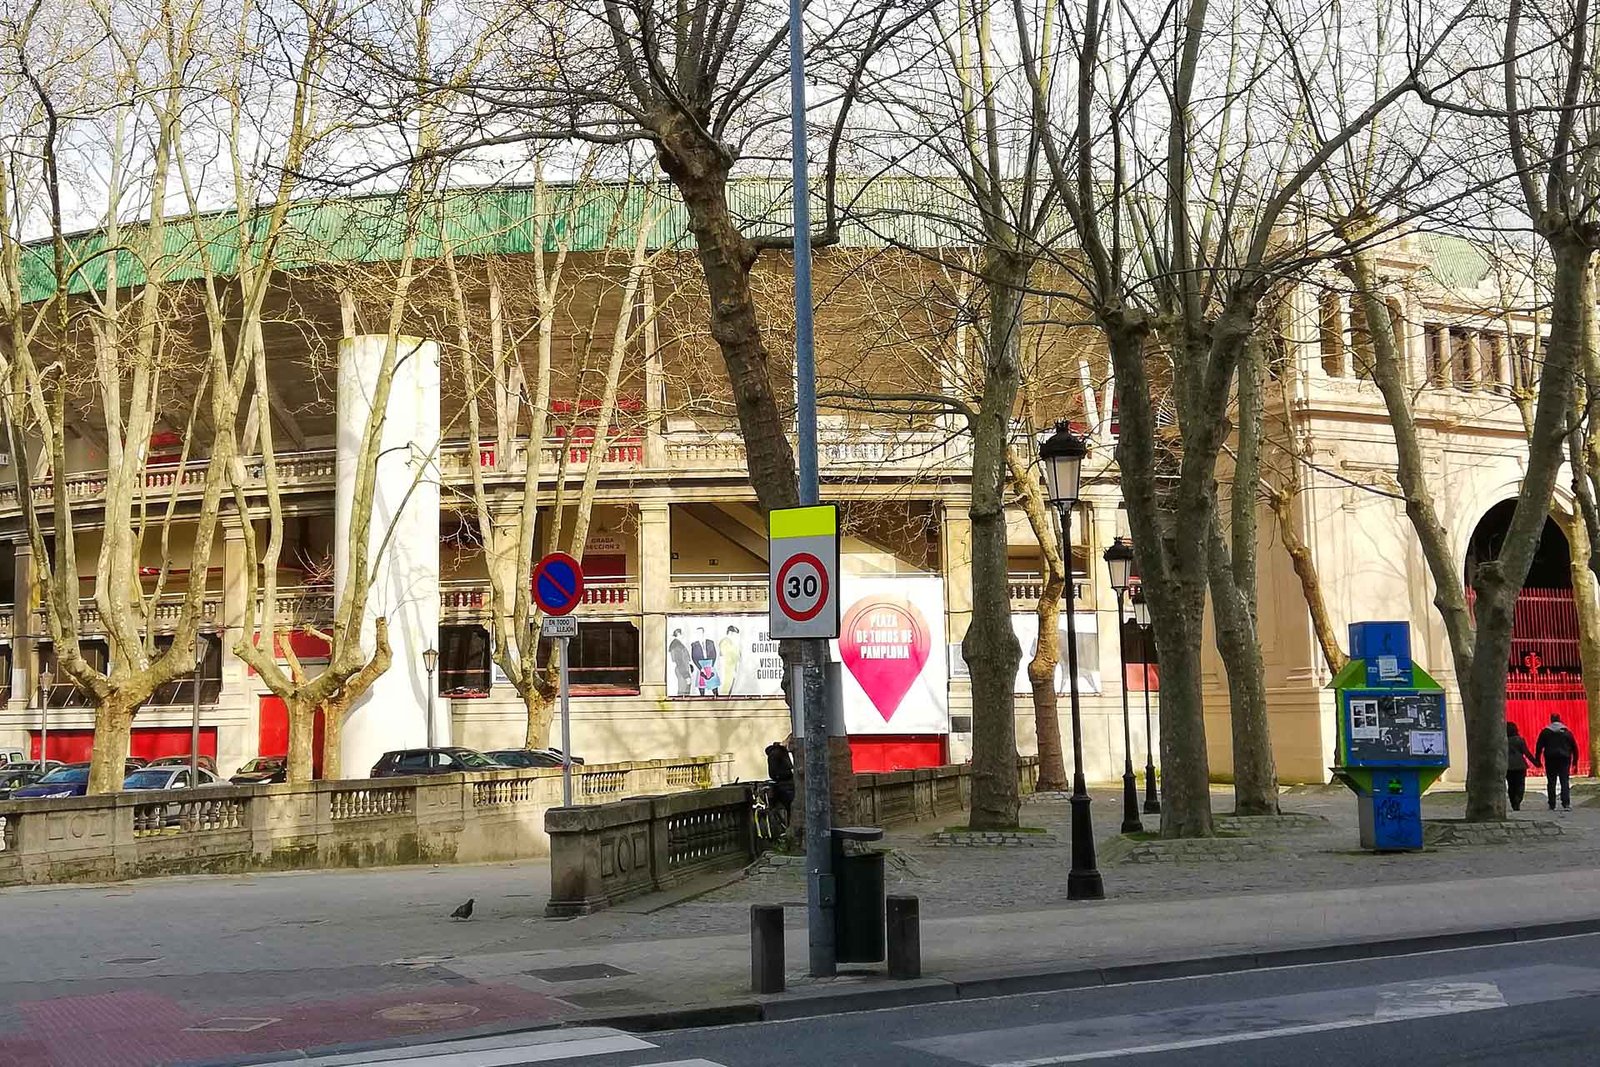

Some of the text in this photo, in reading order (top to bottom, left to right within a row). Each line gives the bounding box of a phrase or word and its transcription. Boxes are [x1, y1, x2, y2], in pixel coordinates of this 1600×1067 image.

[787, 575, 818, 598] 30
[870, 613, 898, 628] PLAZA
[856, 629, 914, 644] DE TOROS DE
[860, 645, 911, 660] PAMPLONA
